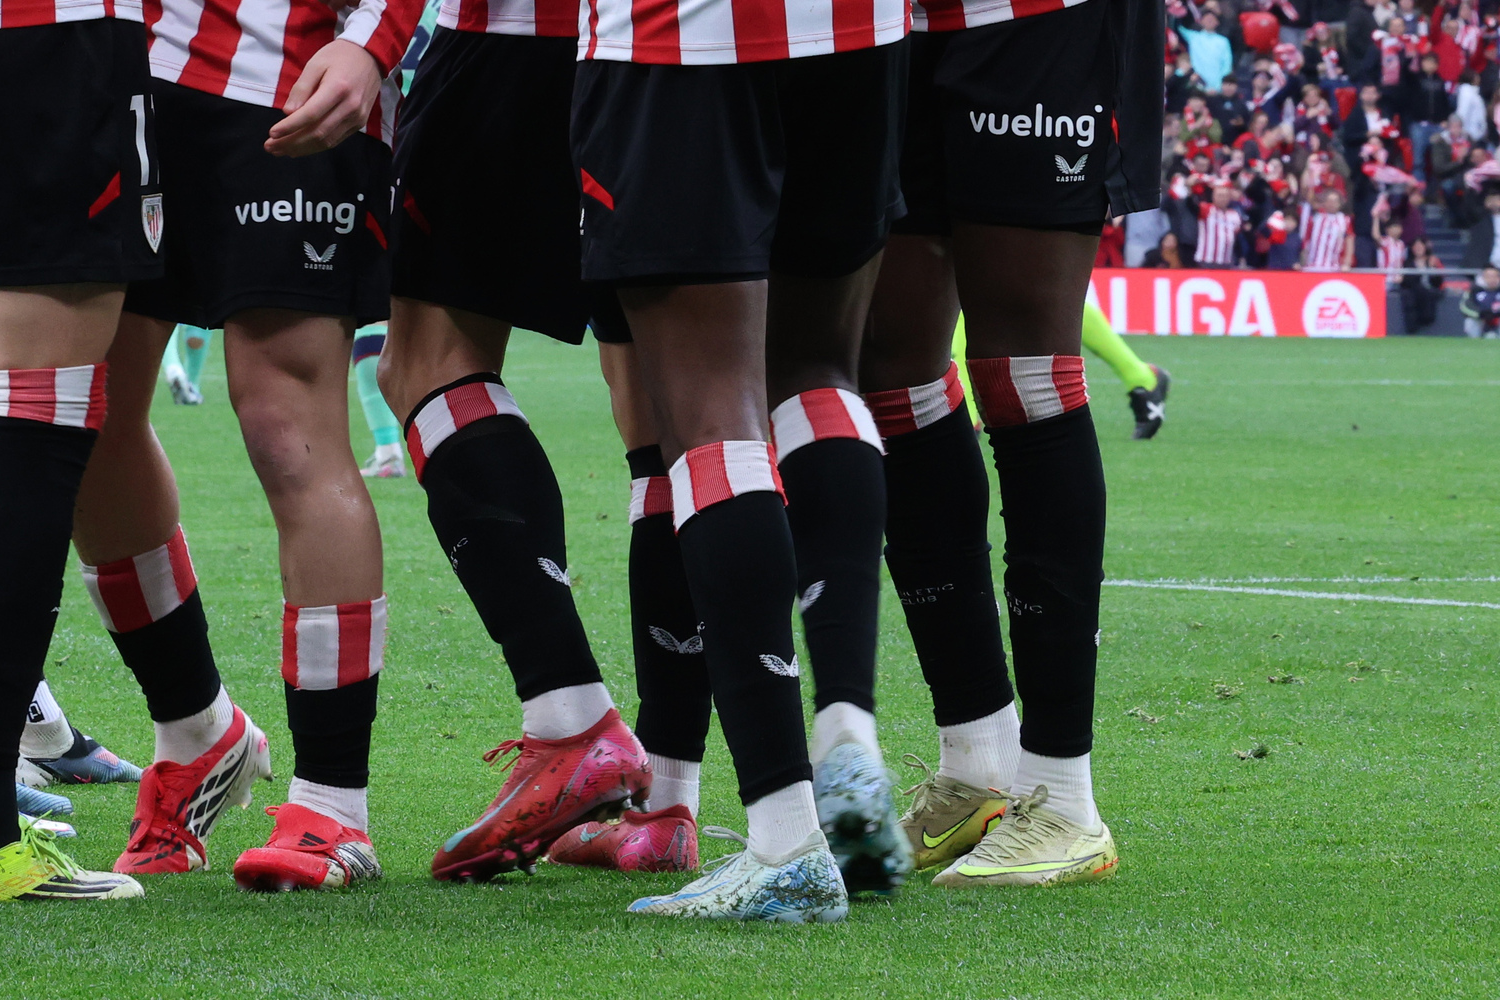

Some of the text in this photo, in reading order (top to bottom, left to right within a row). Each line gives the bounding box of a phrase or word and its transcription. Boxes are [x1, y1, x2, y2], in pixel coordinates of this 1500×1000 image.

[969, 102, 1103, 148] vueling
[1055, 174, 1086, 183] CASTORE
[234, 188, 364, 235] vueling
[1086, 276, 1276, 337] LIGA
[1318, 297, 1356, 319] EA
